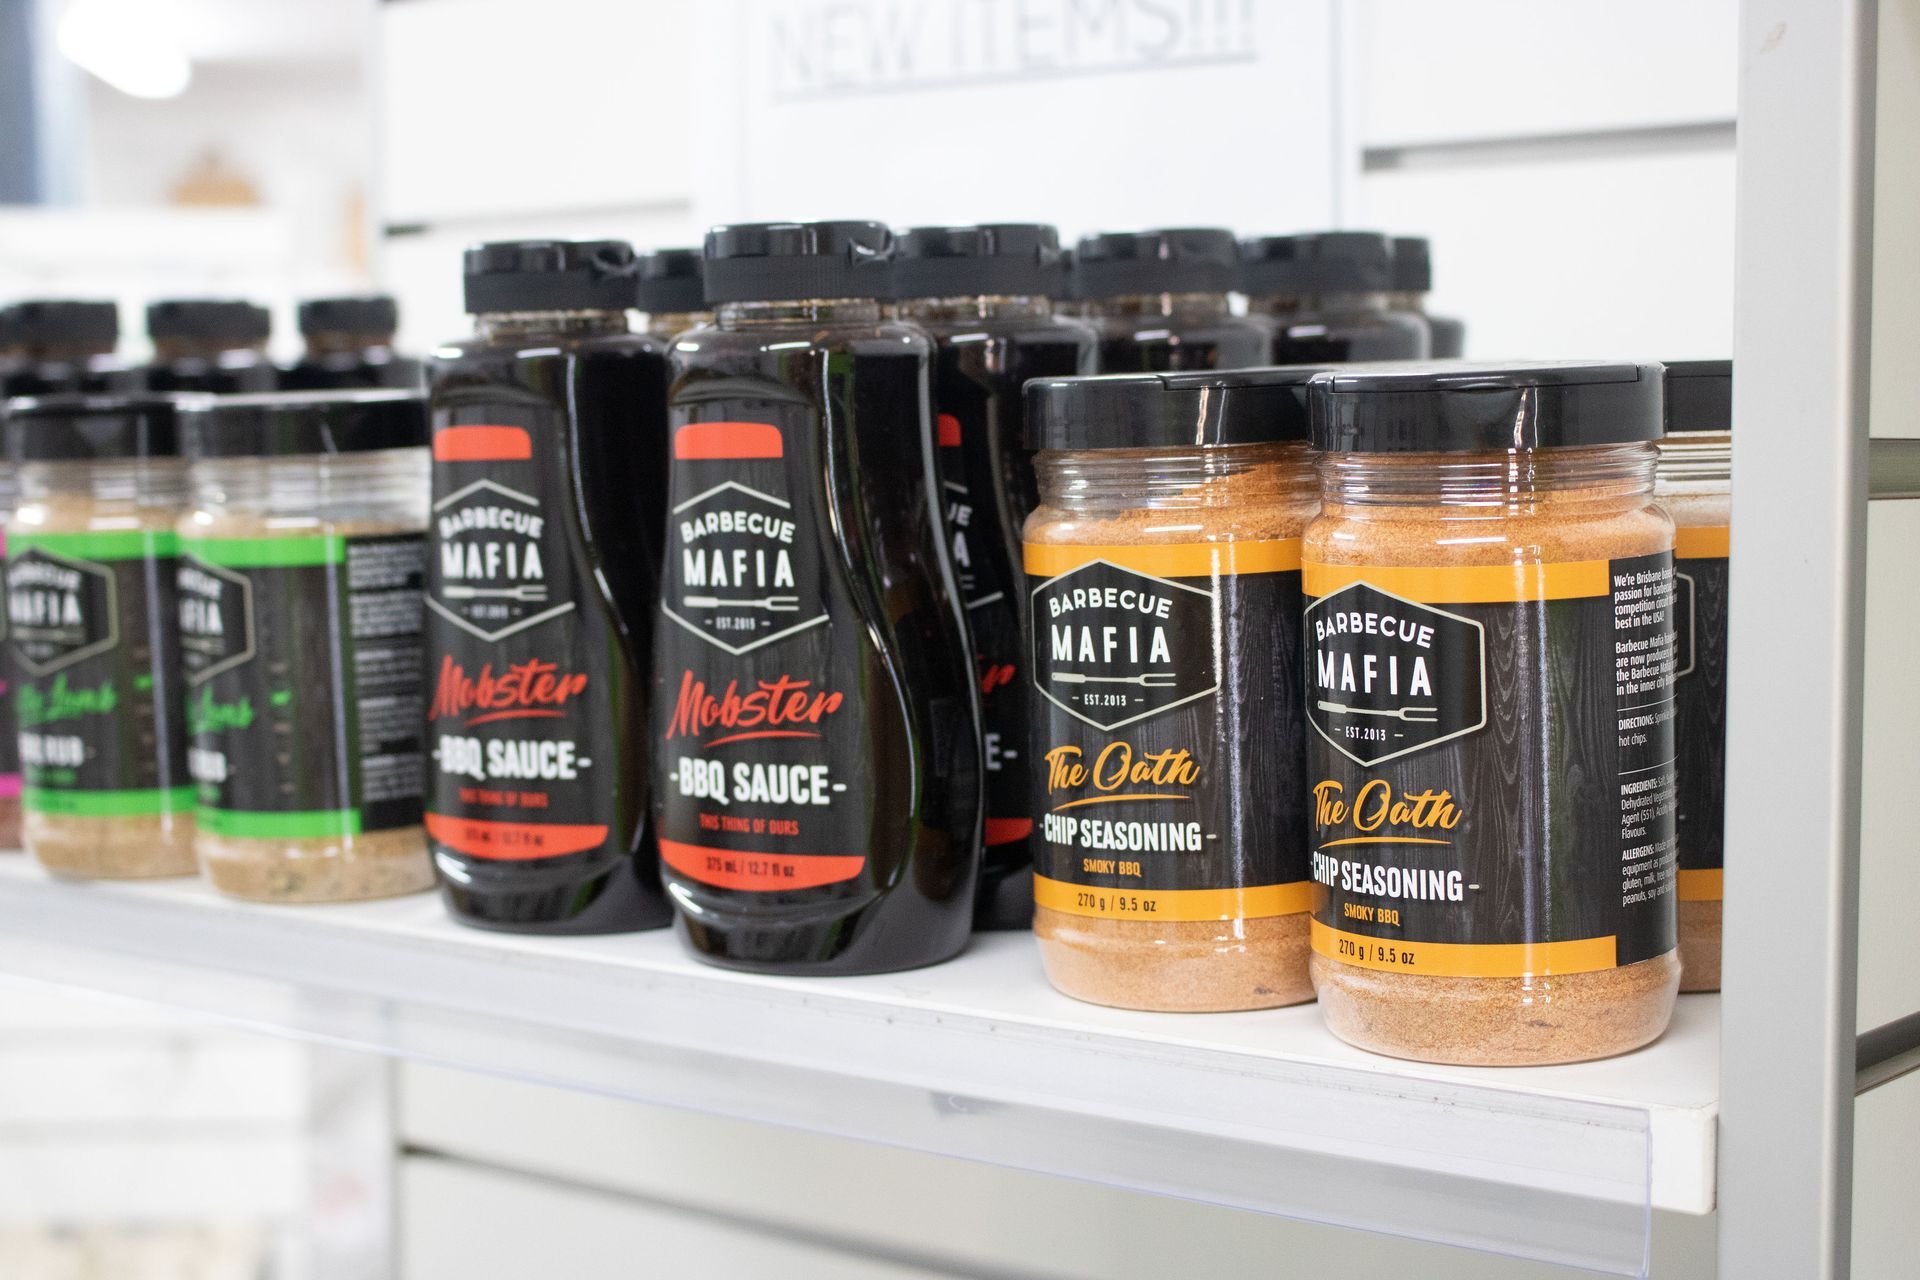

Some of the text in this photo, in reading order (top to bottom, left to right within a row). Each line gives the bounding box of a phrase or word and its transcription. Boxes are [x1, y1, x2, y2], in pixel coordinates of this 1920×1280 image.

[771, 2, 925, 90] NEW
[438, 506, 545, 540] BARBECUE
[680, 510, 796, 544] BARBECUE
[440, 541, 544, 580] MAFIA
[683, 548, 795, 588] MAFIA
[1614, 573, 1635, 587] We're
[1636, 570, 1661, 584] Brisbane
[1049, 587, 1173, 619] BARBECUE
[1614, 587, 1643, 604] passion
[1643, 585, 1652, 597] for
[1614, 599, 1655, 617] competition
[1316, 612, 1435, 649] BARBECUE
[1615, 615, 1632, 630] best
[1633, 615, 1640, 627] in
[1641, 613, 1652, 626] the
[1051, 624, 1171, 664] MAFIA
[1615, 639, 1648, 654] Barbecue
[1649, 634, 1664, 648] Mafia
[1616, 657, 1629, 668] are
[1630, 655, 1645, 666] now
[1317, 649, 1432, 696] MAFIA
[1616, 669, 1629, 682] the
[1631, 665, 1659, 680] Barbecue
[427, 655, 588, 721] Mobster
[1616, 683, 1624, 696] in
[1626, 681, 1639, 695] the
[1639, 680, 1656, 692] inner
[1656, 676, 1665, 690] city
[665, 669, 844, 740] Mobster
[1618, 714, 1654, 731] DIRECTIONS:
[1618, 733, 1647, 747] hot chips.
[1044, 745, 1089, 796] The
[1093, 741, 1201, 791] Oath
[1620, 778, 1658, 795] INGREDIENTS:
[1312, 779, 1463, 832] The Oath
[1621, 792, 1653, 811] Dehydrated
[699, 812, 800, 836] THIS THING OF OURS
[1621, 812, 1640, 827] Agent
[1044, 813, 1202, 851] CHIP SEASONING
[1621, 826, 1647, 840] Flavours.
[1622, 844, 1655, 861] ALLERGENS:
[1083, 858, 1142, 877] SMOKY BBQ
[1313, 850, 1463, 902] CHIP SEASONING
[1622, 859, 1653, 877] equipment
[1653, 858, 1658, 868] as
[1622, 878, 1643, 893] gluten,
[1078, 893, 1095, 908] 270
[1099, 899, 1105, 911] g
[1119, 898, 1138, 911] 9.5
[1143, 900, 1156, 912] oz
[1622, 890, 1647, 907] peanuts,
[1647, 889, 1657, 900] soy
[1344, 902, 1400, 927] SMOKY BBQ
[1339, 938, 1415, 965] 270 g / 9.5 oz
